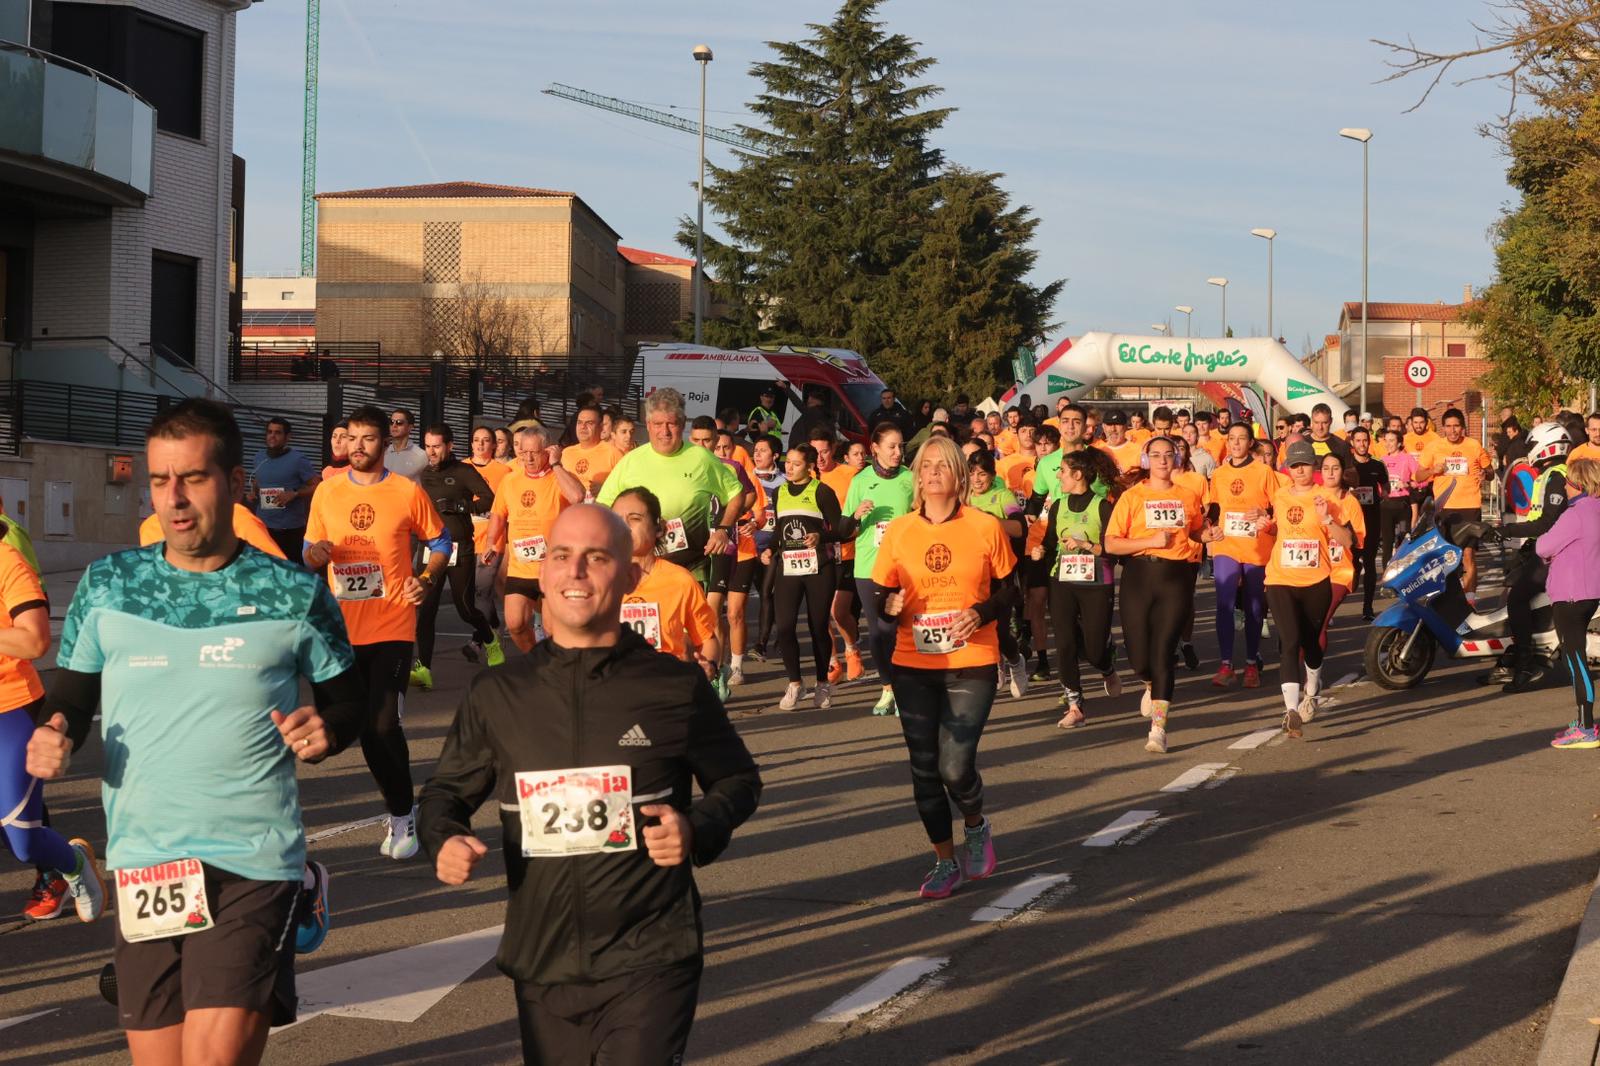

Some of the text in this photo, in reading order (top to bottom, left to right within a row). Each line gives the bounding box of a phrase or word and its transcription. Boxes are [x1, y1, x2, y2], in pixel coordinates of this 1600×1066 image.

[703, 353, 760, 362] AMBULANCIA
[1118, 342, 1248, 373] El Corte Inglés
[1411, 366, 1428, 377] 30
[688, 392, 710, 403] Roja
[1153, 510, 1177, 520] 313
[1231, 521, 1250, 531] 252
[344, 535, 376, 546] UPSA
[523, 546, 536, 557] 33
[1289, 550, 1310, 560] 141
[333, 563, 381, 576] bedunia
[791, 559, 811, 569] 513
[1066, 563, 1087, 575] 275
[1418, 558, 1440, 574] 112
[346, 576, 368, 592] 22
[921, 576, 958, 588] UPSA
[622, 608, 657, 619] unia
[618, 738, 651, 746] adidas
[541, 798, 609, 835] 238
[135, 882, 186, 919] 265
